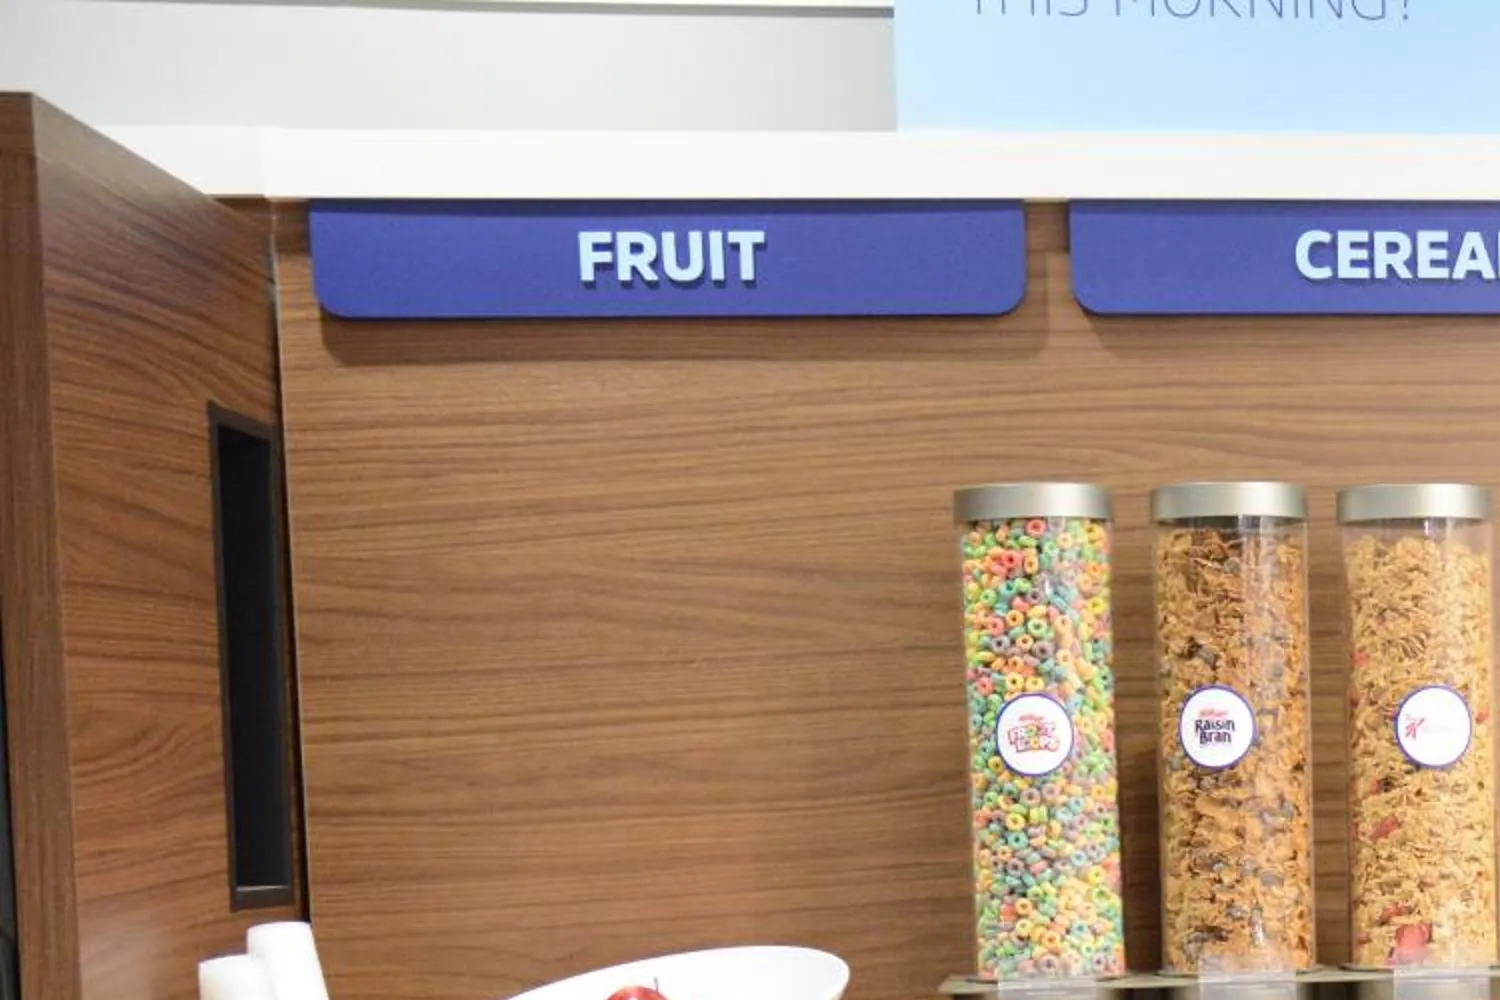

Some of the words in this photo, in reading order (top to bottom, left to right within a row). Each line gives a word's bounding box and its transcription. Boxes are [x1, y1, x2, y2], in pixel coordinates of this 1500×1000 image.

[578, 230, 765, 282] FRUIT
[1194, 719, 1235, 732] Raisin
[1199, 731, 1232, 745] Bran
